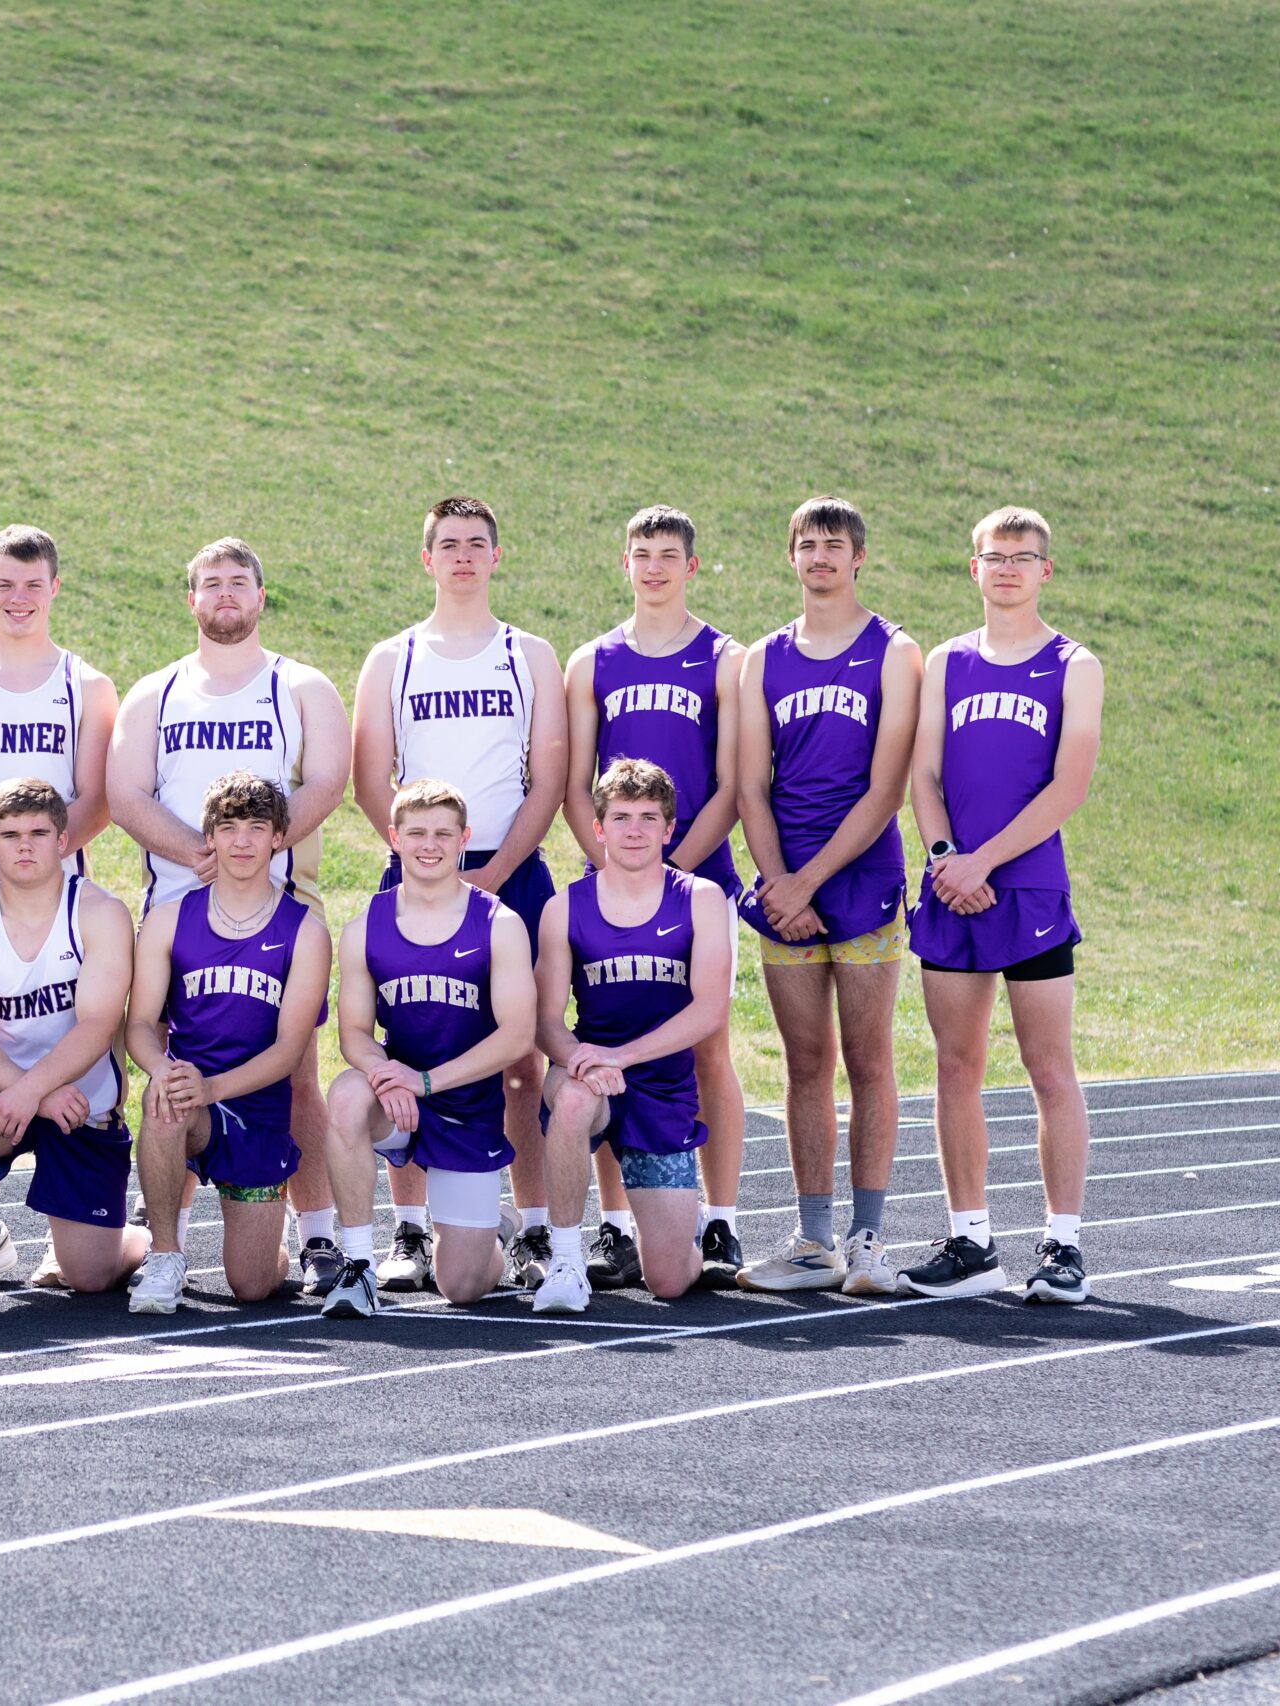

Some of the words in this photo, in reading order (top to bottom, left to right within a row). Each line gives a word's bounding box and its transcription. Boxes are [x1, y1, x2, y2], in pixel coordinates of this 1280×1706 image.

[409, 689, 514, 721] WINNER
[605, 684, 703, 725] WINNER
[775, 685, 868, 727] WINNER
[951, 691, 1048, 737] WINNER
[163, 720, 272, 754] WINNER
[183, 967, 283, 1008] WINNER
[583, 955, 687, 987] WINNER
[379, 974, 480, 1010] WINNER
